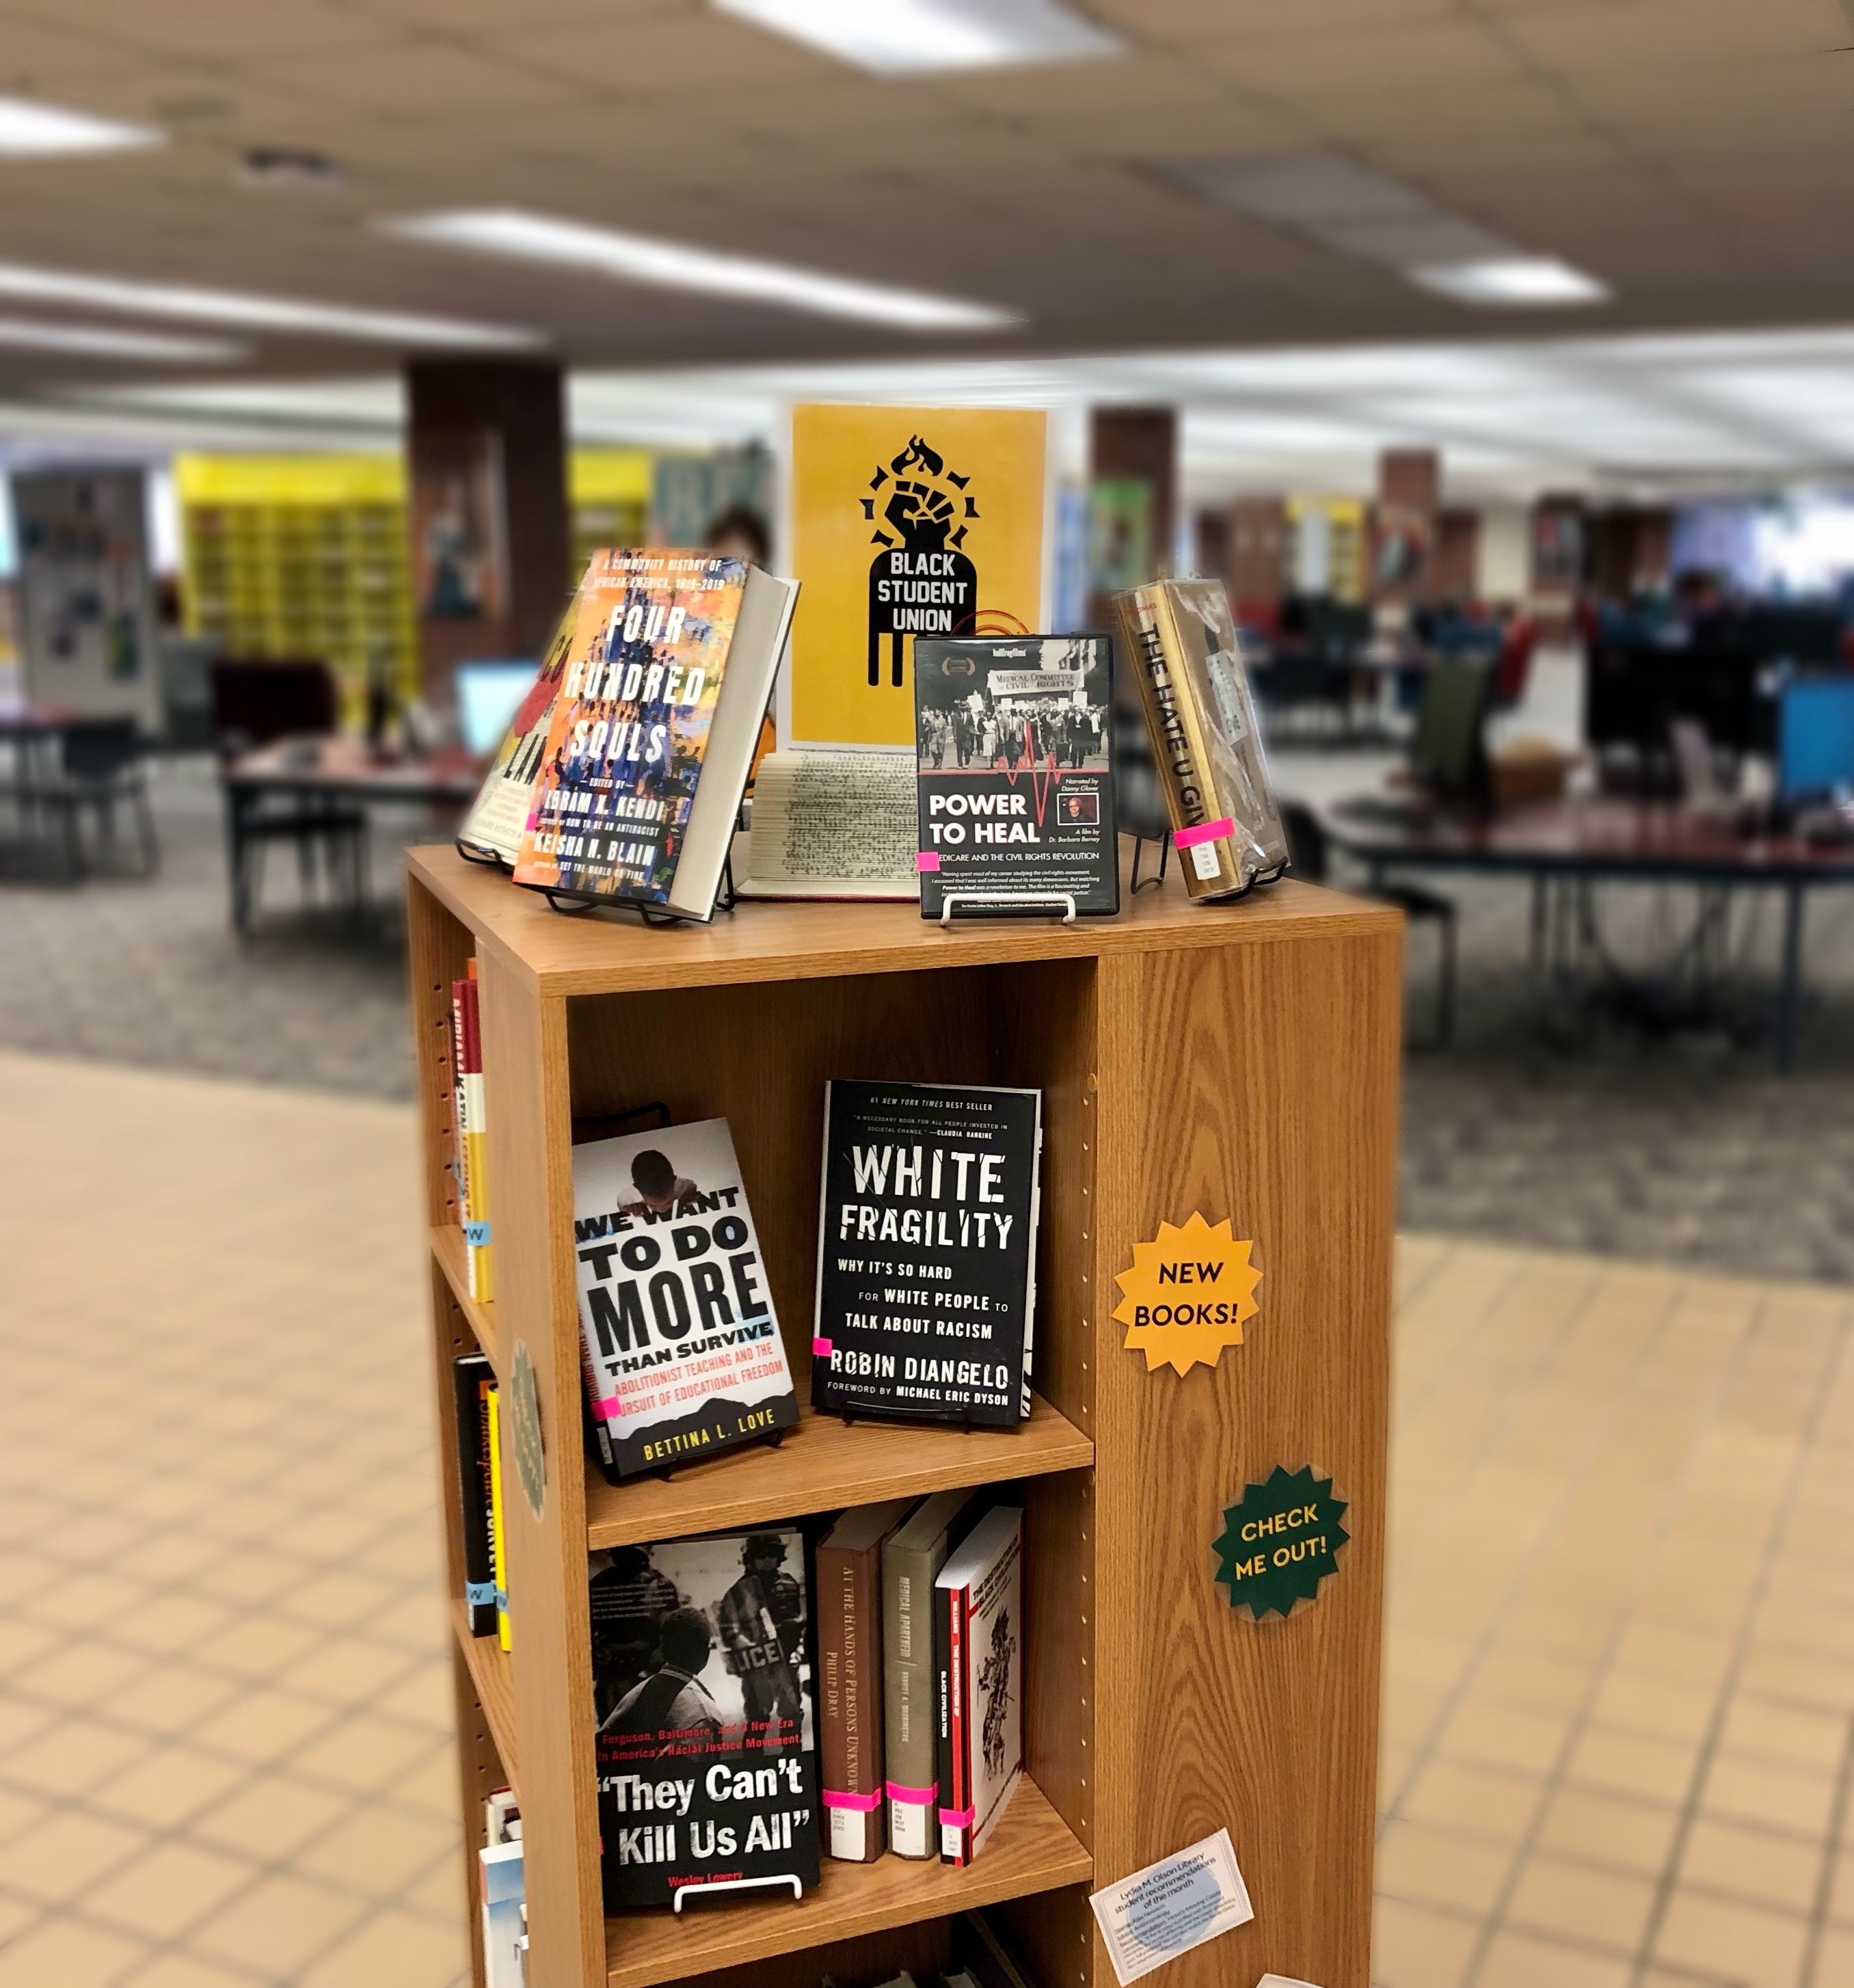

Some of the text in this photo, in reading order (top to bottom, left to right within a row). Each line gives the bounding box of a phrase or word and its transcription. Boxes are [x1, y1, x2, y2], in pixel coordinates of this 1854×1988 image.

[612, 559, 722, 571] COMMUNITY HISTORY OF
[891, 552, 956, 576] BLACK
[878, 580, 968, 604] STUDENT
[606, 604, 686, 644] FOUR
[893, 608, 952, 631] UNION
[1139, 623, 1168, 678] THE
[564, 662, 706, 706] HUNDRED
[996, 673, 1075, 683] MEDICAL COMMITTEE
[1006, 680, 1075, 690] CIVIL RIGHTS
[1153, 684, 1188, 752] HATE
[570, 719, 667, 764] SOULS
[589, 777, 625, 789] EDITED BY
[1172, 761, 1194, 777] U
[544, 790, 593, 814] IBRAM
[595, 794, 609, 815] X.
[615, 796, 665, 821] KENDI
[929, 794, 1027, 816] POWER
[1181, 785, 1205, 829] GIV
[566, 818, 581, 827] HOW
[582, 820, 591, 829] TO
[616, 823, 660, 837] ANTIRACIST
[929, 822, 1040, 844] TO HEAL
[533, 833, 656, 866] KEISHA N. BLAIN
[971, 853, 989, 861] AND
[991, 853, 1004, 861] THE
[1052, 852, 1099, 861] REVOLUTION
[559, 861, 570, 871] SET
[573, 863, 585, 872] THE
[589, 865, 611, 876] WORLD
[626, 869, 644, 881] FIRE
[882, 1097, 898, 1105] NEW
[922, 1099, 943, 1108] TIMES
[945, 1101, 963, 1110] BEST
[966, 1103, 993, 1111] SELLER
[852, 1144, 1006, 1203] WHITE
[575, 1186, 740, 1242] WE WANT
[839, 1204, 1014, 1250] FRAGILITY
[469, 1227, 483, 1241] W
[578, 1215, 749, 1281] TO DO
[838, 1258, 952, 1280] WHY IT'S SO HARD
[1159, 1261, 1224, 1285] NEW
[587, 1250, 769, 1358] MORE
[859, 1288, 1008, 1313] FOR WHITE PEOPLE TO
[1135, 1302, 1239, 1327] BOOKS!
[845, 1313, 993, 1340] TALK ABOUT RACISM
[604, 1321, 774, 1378] THAN SURVIVE
[615, 1342, 774, 1397] ABOLITIONIST TEACHING AND THE
[830, 1349, 1010, 1390] ROBIN DIANGELO
[617, 1359, 783, 1418] URSUIT OF EDUCATIONAL FREEDOM
[827, 1381, 1009, 1407] FOREWORD BY MICHAEL ERIC DYSON
[643, 1408, 775, 1462] BETTINA L. LOVE
[1240, 1503, 1319, 1542] CHECK
[1235, 1535, 1326, 1581] ME OUT!
[844, 1588, 855, 1610] THE
[899, 1576, 911, 1658] MEDICAL APARTHEID
[844, 1614, 857, 1656] HANDS
[845, 1660, 857, 1675] OF
[827, 1652, 839, 1718] PHILIP DRAY
[845, 1680, 858, 1732] PERSONS
[598, 1734, 799, 1761] in America's Racial Justice Movement
[602, 1733, 654, 1746] Ferguson,
[718, 1725, 737, 1734] and
[751, 1721, 772, 1732] New
[777, 1719, 794, 1729] Era
[706, 1758, 803, 1802] Can’t
[619, 1824, 676, 1866] Kill
[689, 1820, 737, 1859] Us
[668, 1870, 743, 1887] Wesley Lowery
[1114, 1857, 1216, 1914] student recommendations
[1120, 1885, 1142, 1900] Lydia
[1153, 1867, 1178, 1882] Olson
[1177, 1852, 1205, 1871] Library
[1143, 1879, 1194, 1909] of the month
